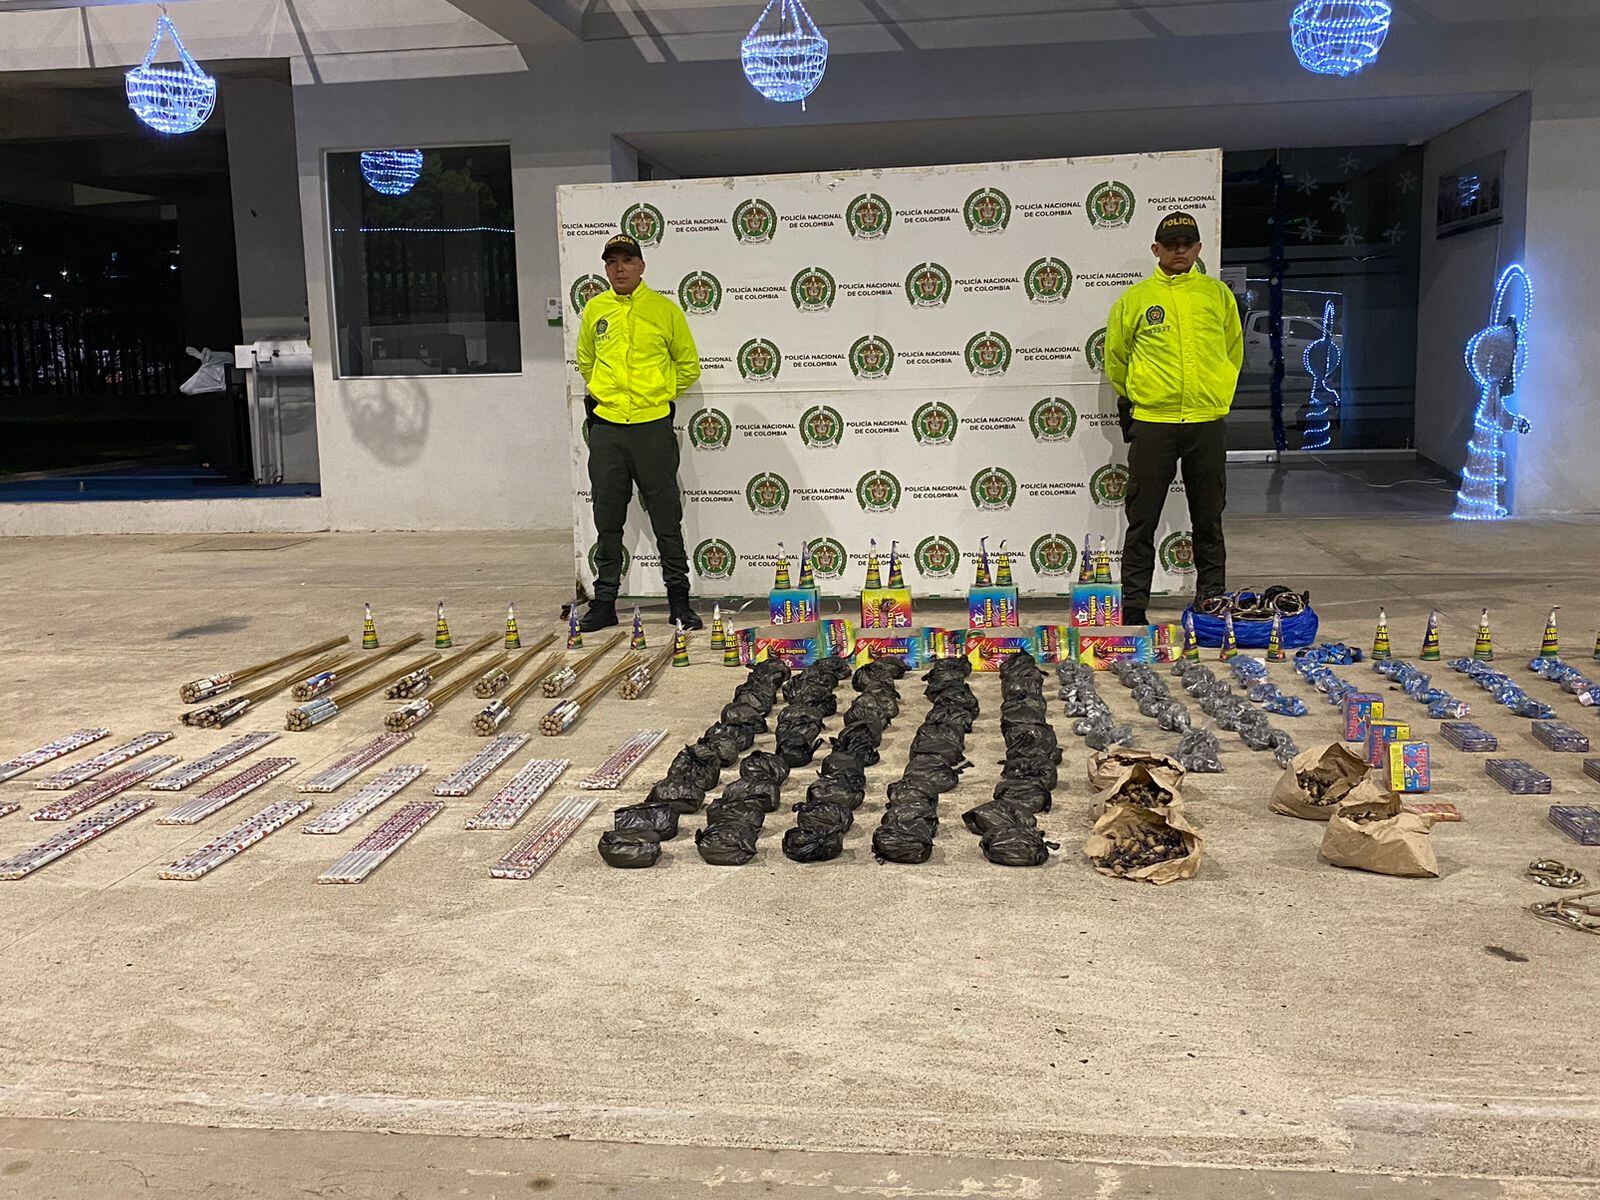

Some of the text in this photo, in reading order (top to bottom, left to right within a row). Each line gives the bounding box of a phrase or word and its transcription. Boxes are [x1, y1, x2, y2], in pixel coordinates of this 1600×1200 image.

[1148, 195, 1216, 204] POLICÍA NACIONAL
[1015, 203, 1043, 211] POLICÍA
[1169, 203, 1206, 211] COLOMBIA
[896, 209, 923, 217] POLICÍA
[562, 222, 583, 230] OLICÍA
[1163, 217, 1195, 229] POLICIA
[1021, 482, 1047, 490] POLICÍA
